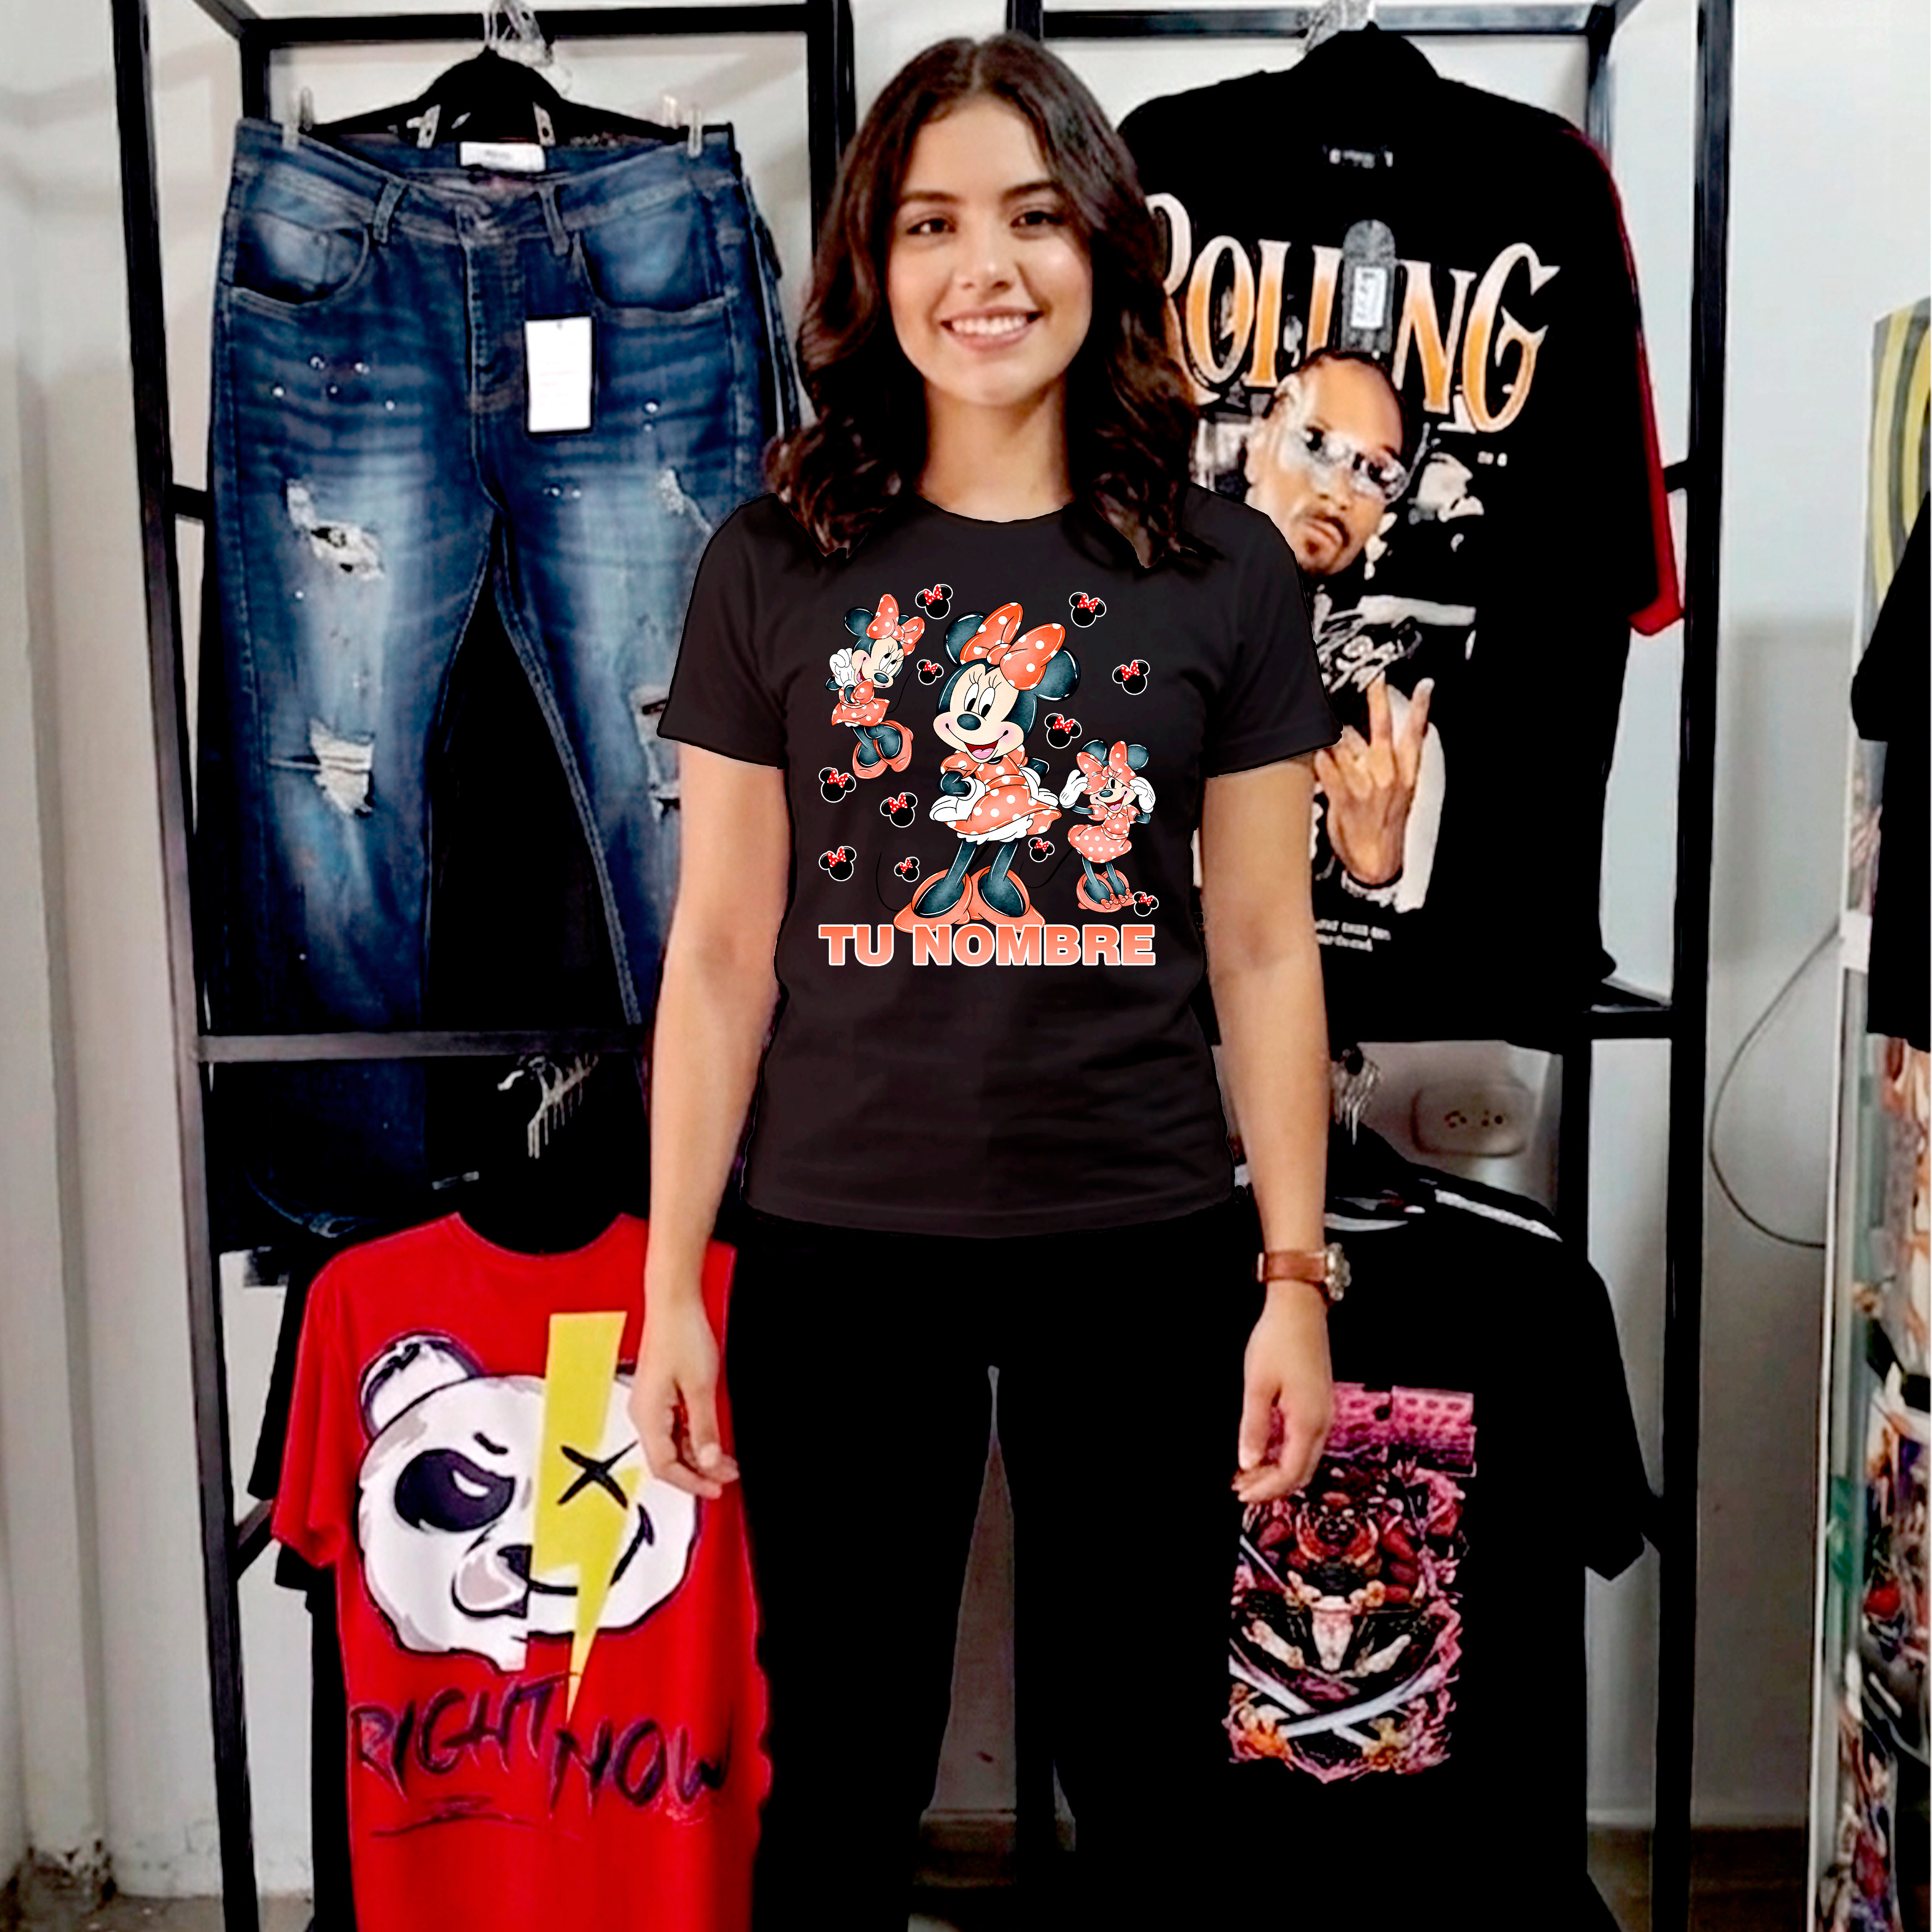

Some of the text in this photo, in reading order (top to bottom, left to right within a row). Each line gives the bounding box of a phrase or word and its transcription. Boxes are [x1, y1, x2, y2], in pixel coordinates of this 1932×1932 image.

[1145, 192, 1560, 433] ROLLNG
[818, 923, 1156, 967] TU NOMBRE
[350, 1672, 735, 1819] RIGHT NOW
